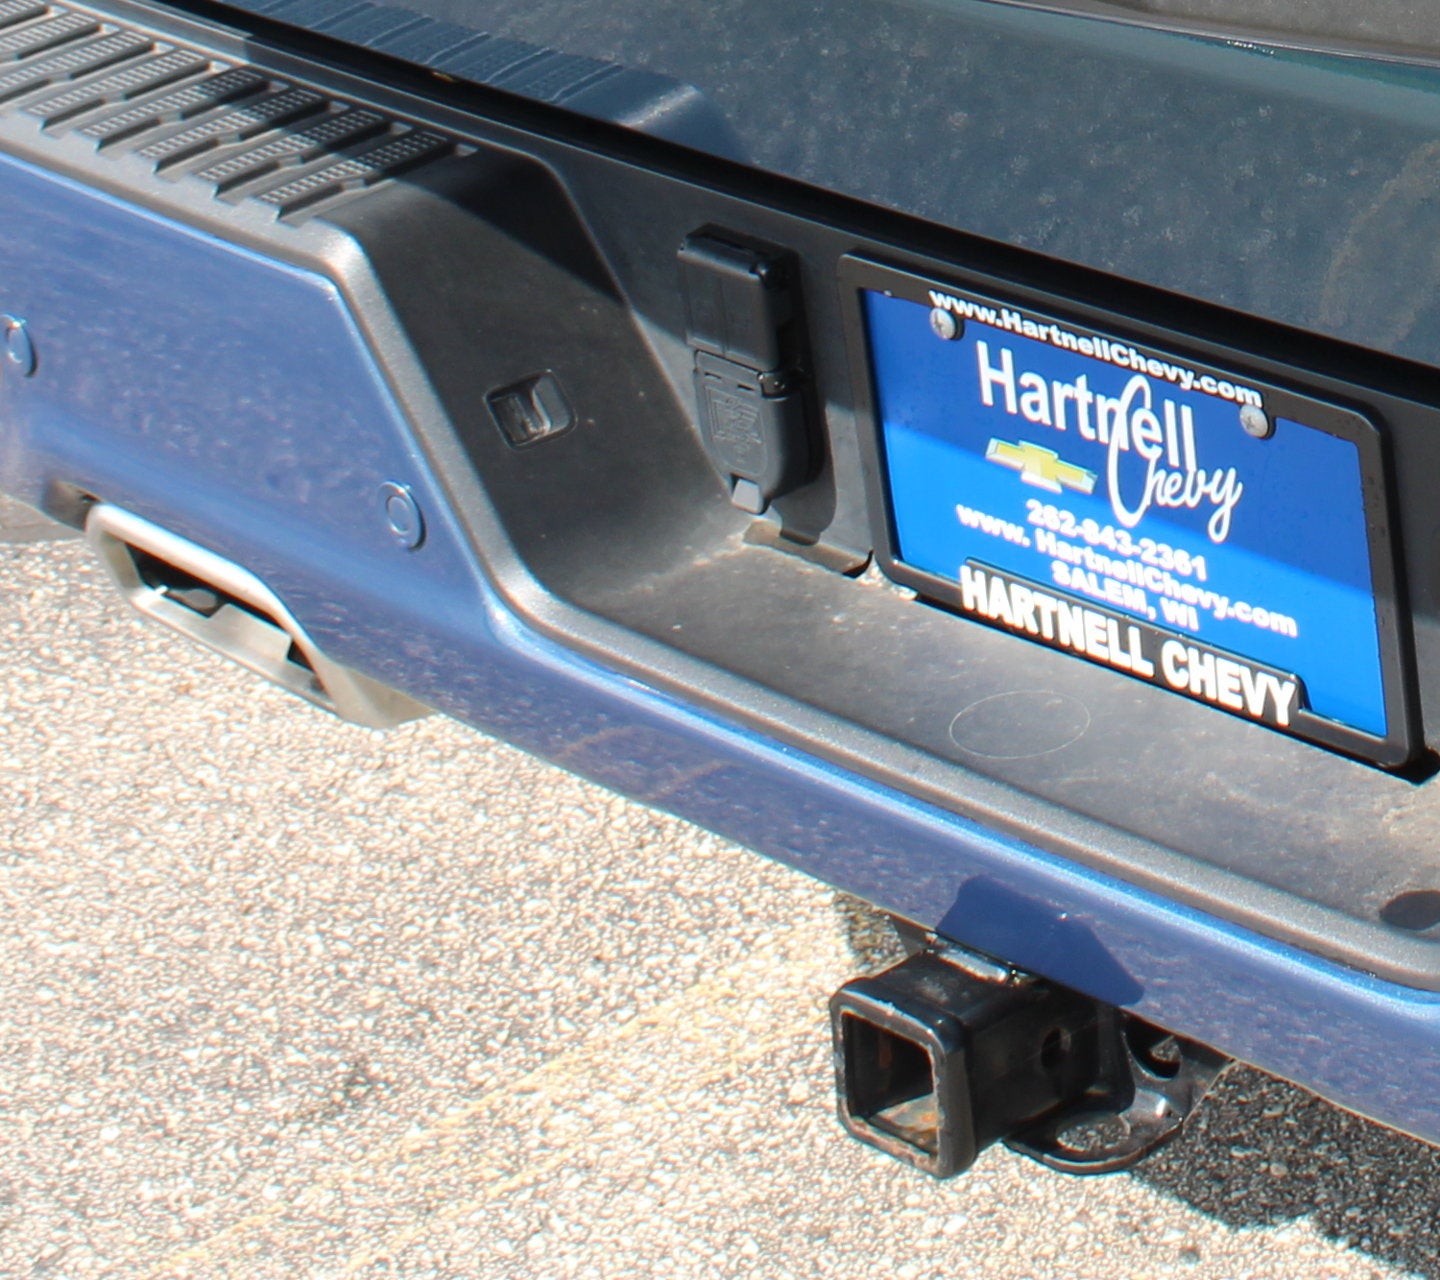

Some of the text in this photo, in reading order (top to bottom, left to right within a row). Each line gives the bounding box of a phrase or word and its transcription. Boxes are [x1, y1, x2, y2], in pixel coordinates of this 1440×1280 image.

[928, 290, 1263, 408] www.HartnellChevy.com
[976, 340, 1197, 474] Hartnell
[1107, 374, 1243, 543] Chevy
[1025, 498, 1207, 582] 262-843-2361
[1035, 527, 1298, 637] HartnellChevy.com
[1051, 560, 1199, 631] SALEM, WI
[959, 564, 1296, 727] HARTNELL CHEVY
